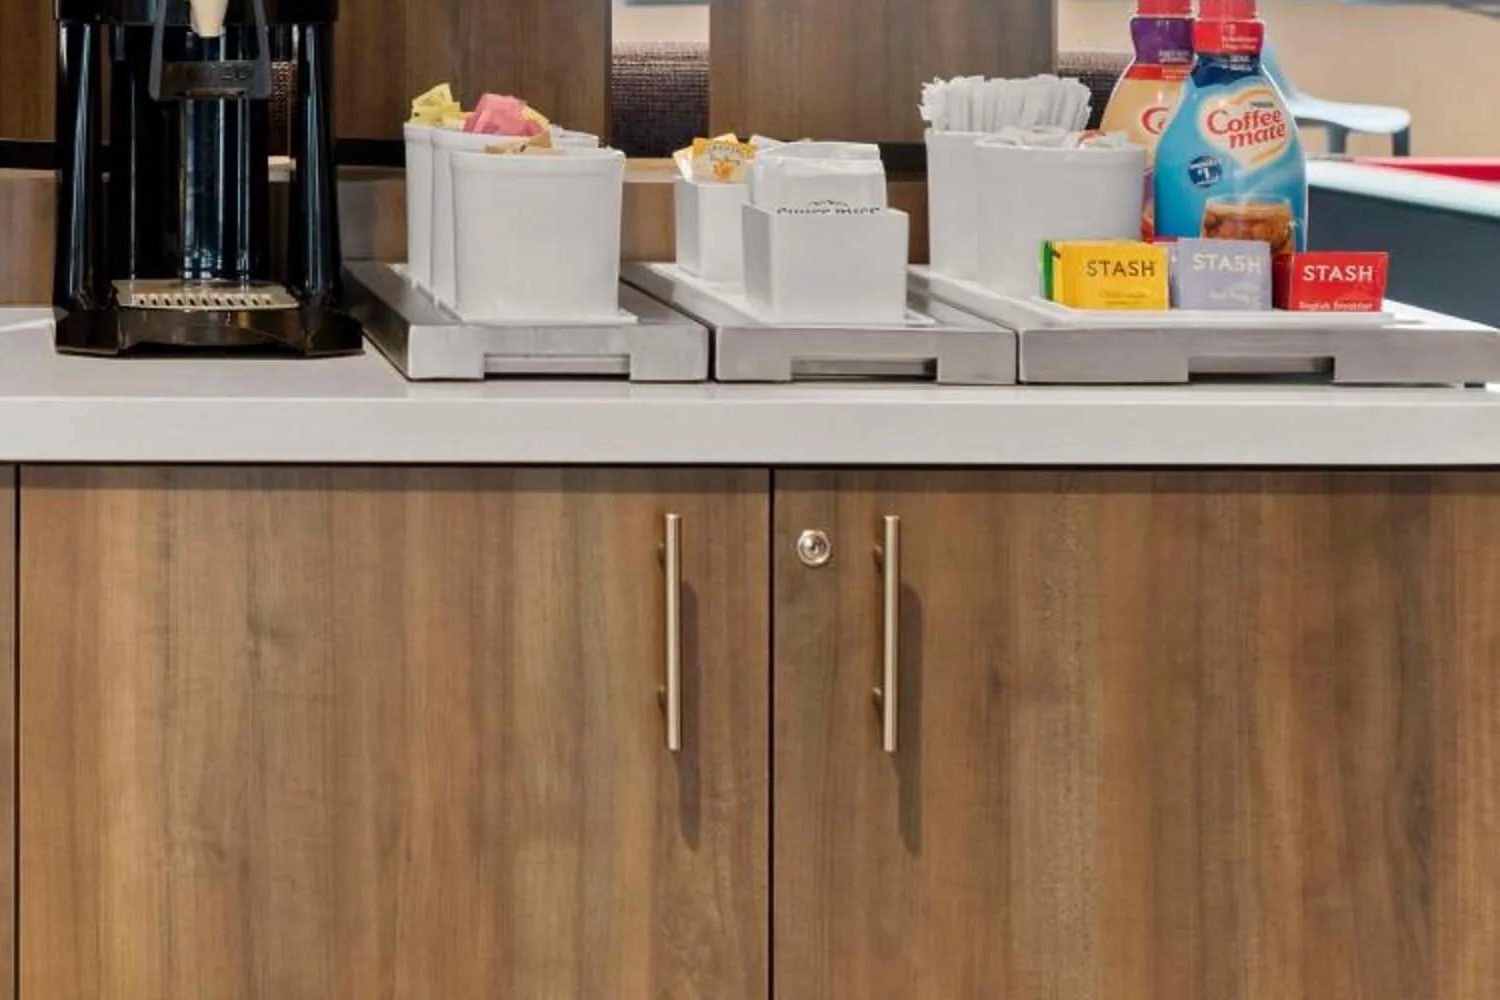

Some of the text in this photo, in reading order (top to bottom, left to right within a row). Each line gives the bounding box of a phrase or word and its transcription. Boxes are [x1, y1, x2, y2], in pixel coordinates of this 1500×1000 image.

[1207, 108, 1282, 136] Coffee
[1228, 123, 1285, 150] mate
[1085, 259, 1156, 278] STASH
[1192, 252, 1262, 276] STASH
[1302, 264, 1374, 282] STASH
